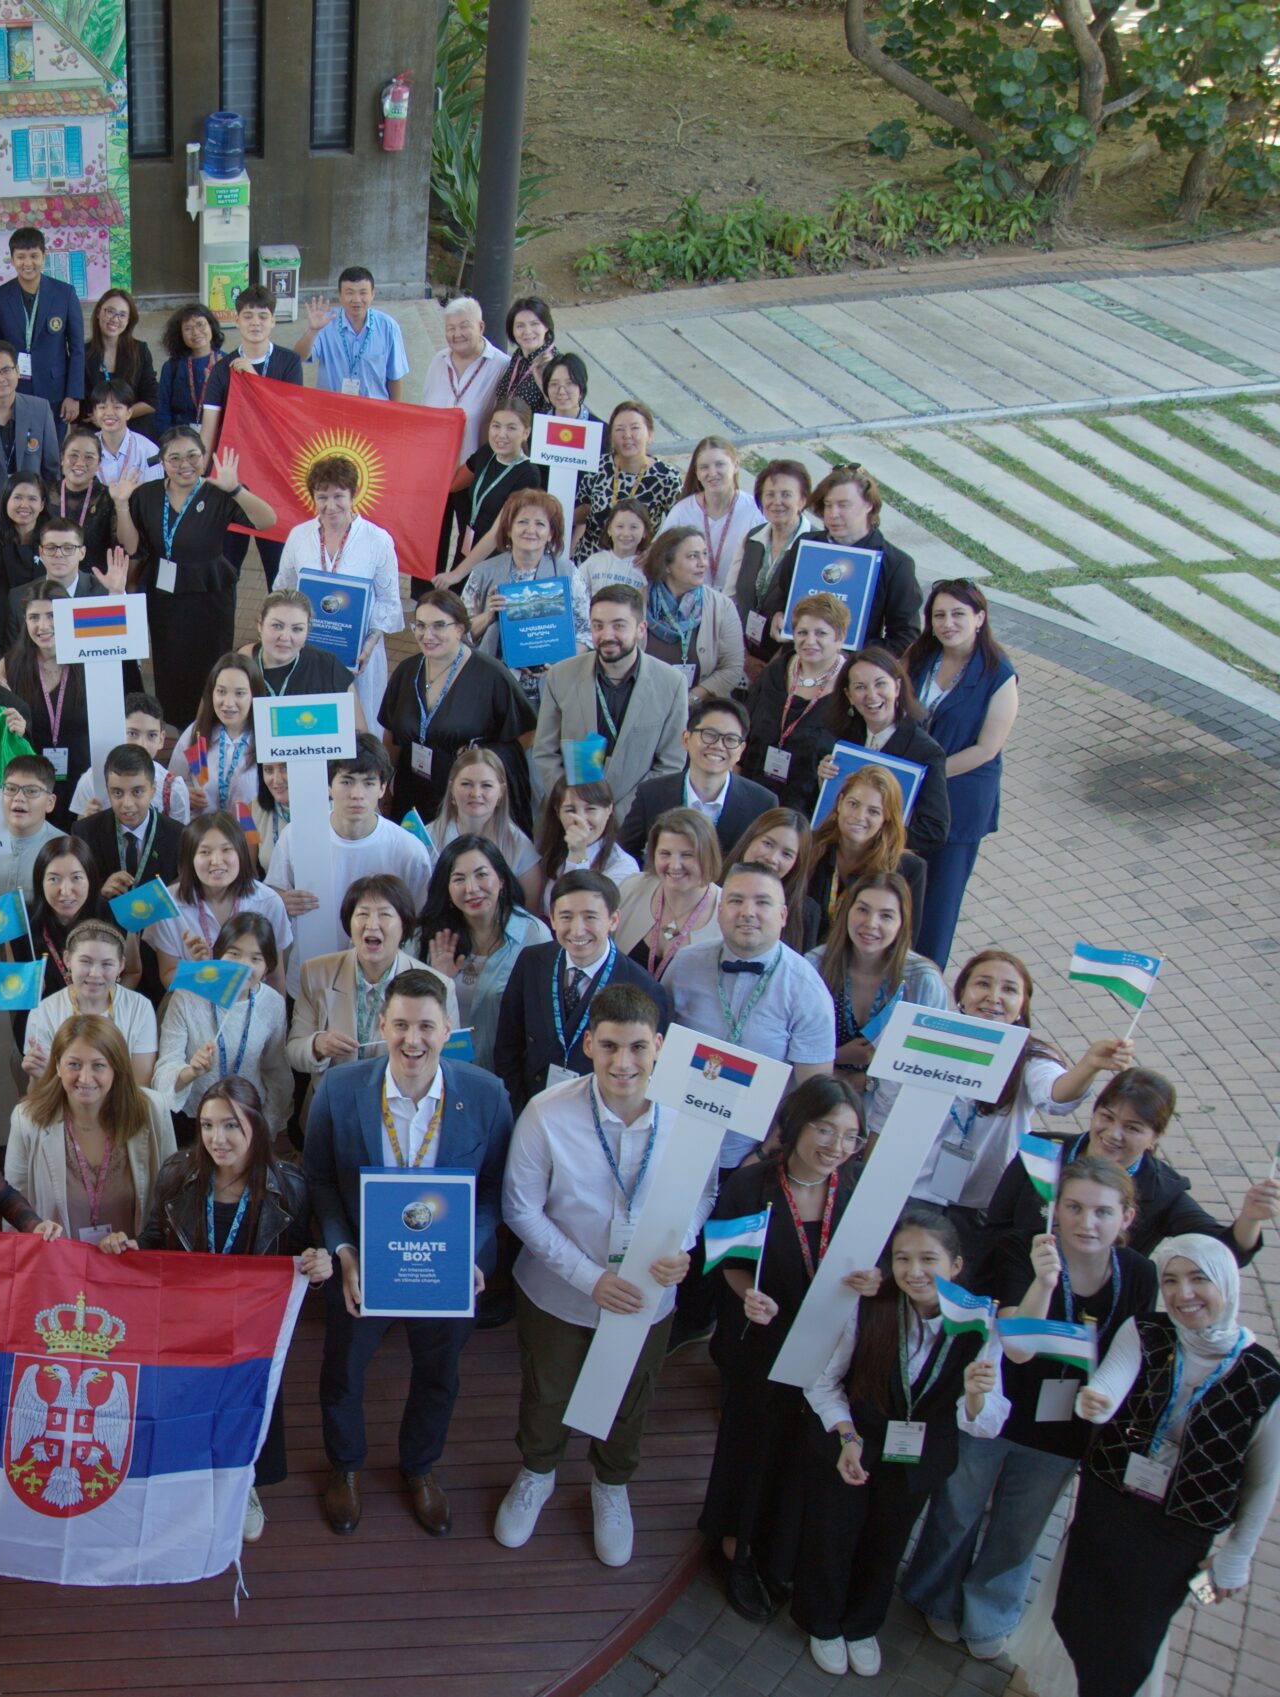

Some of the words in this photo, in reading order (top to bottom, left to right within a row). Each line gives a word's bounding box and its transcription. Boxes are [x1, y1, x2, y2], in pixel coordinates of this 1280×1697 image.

[540, 451, 588, 465] Kyrgyzstan
[78, 645, 128, 658] Armenia
[270, 745, 342, 757] Kazakhstan
[892, 1060, 982, 1089] Uzbekistan
[684, 1094, 732, 1119] Serbia
[387, 1240, 447, 1252] CLIMATE
[402, 1251, 433, 1262] BOX
